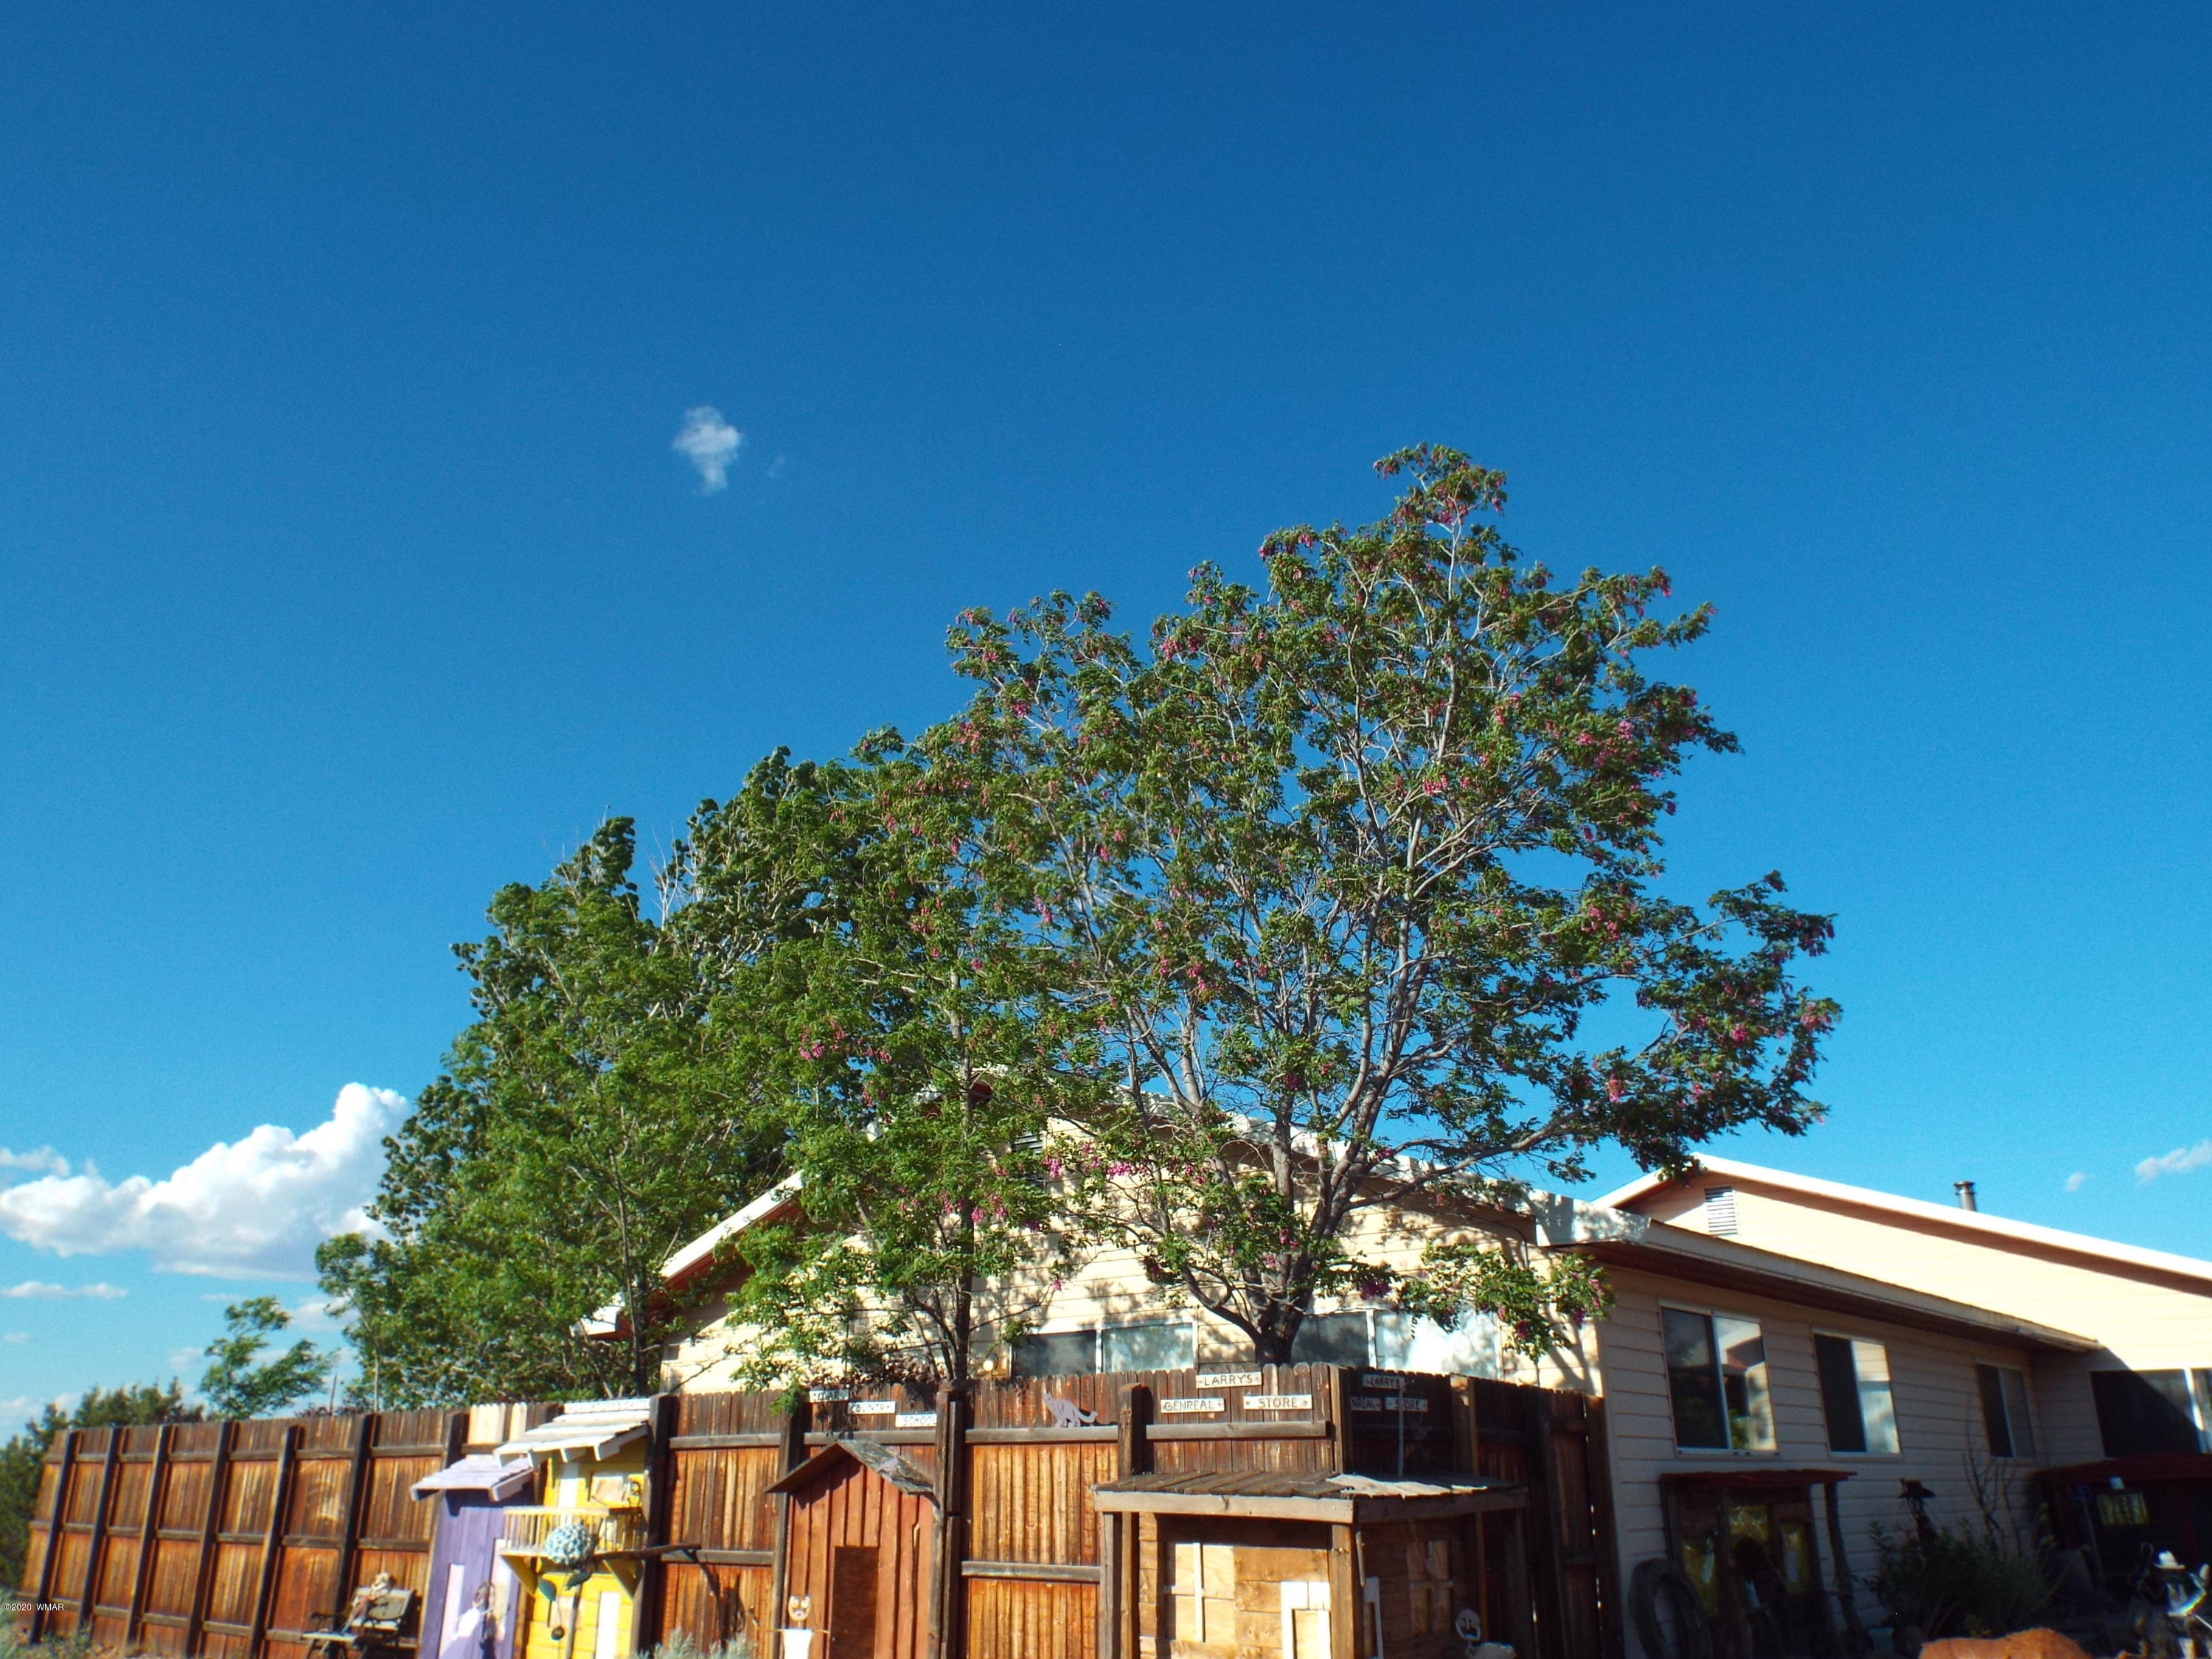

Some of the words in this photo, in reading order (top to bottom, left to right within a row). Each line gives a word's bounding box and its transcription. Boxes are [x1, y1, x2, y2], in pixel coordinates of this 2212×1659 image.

[1204, 1375, 1253, 1386] LARRY'S
[1258, 1397, 1298, 1408] STORE
[1395, 1398, 1419, 1411] SORE
[903, 1416, 937, 1426] SCHOOL
